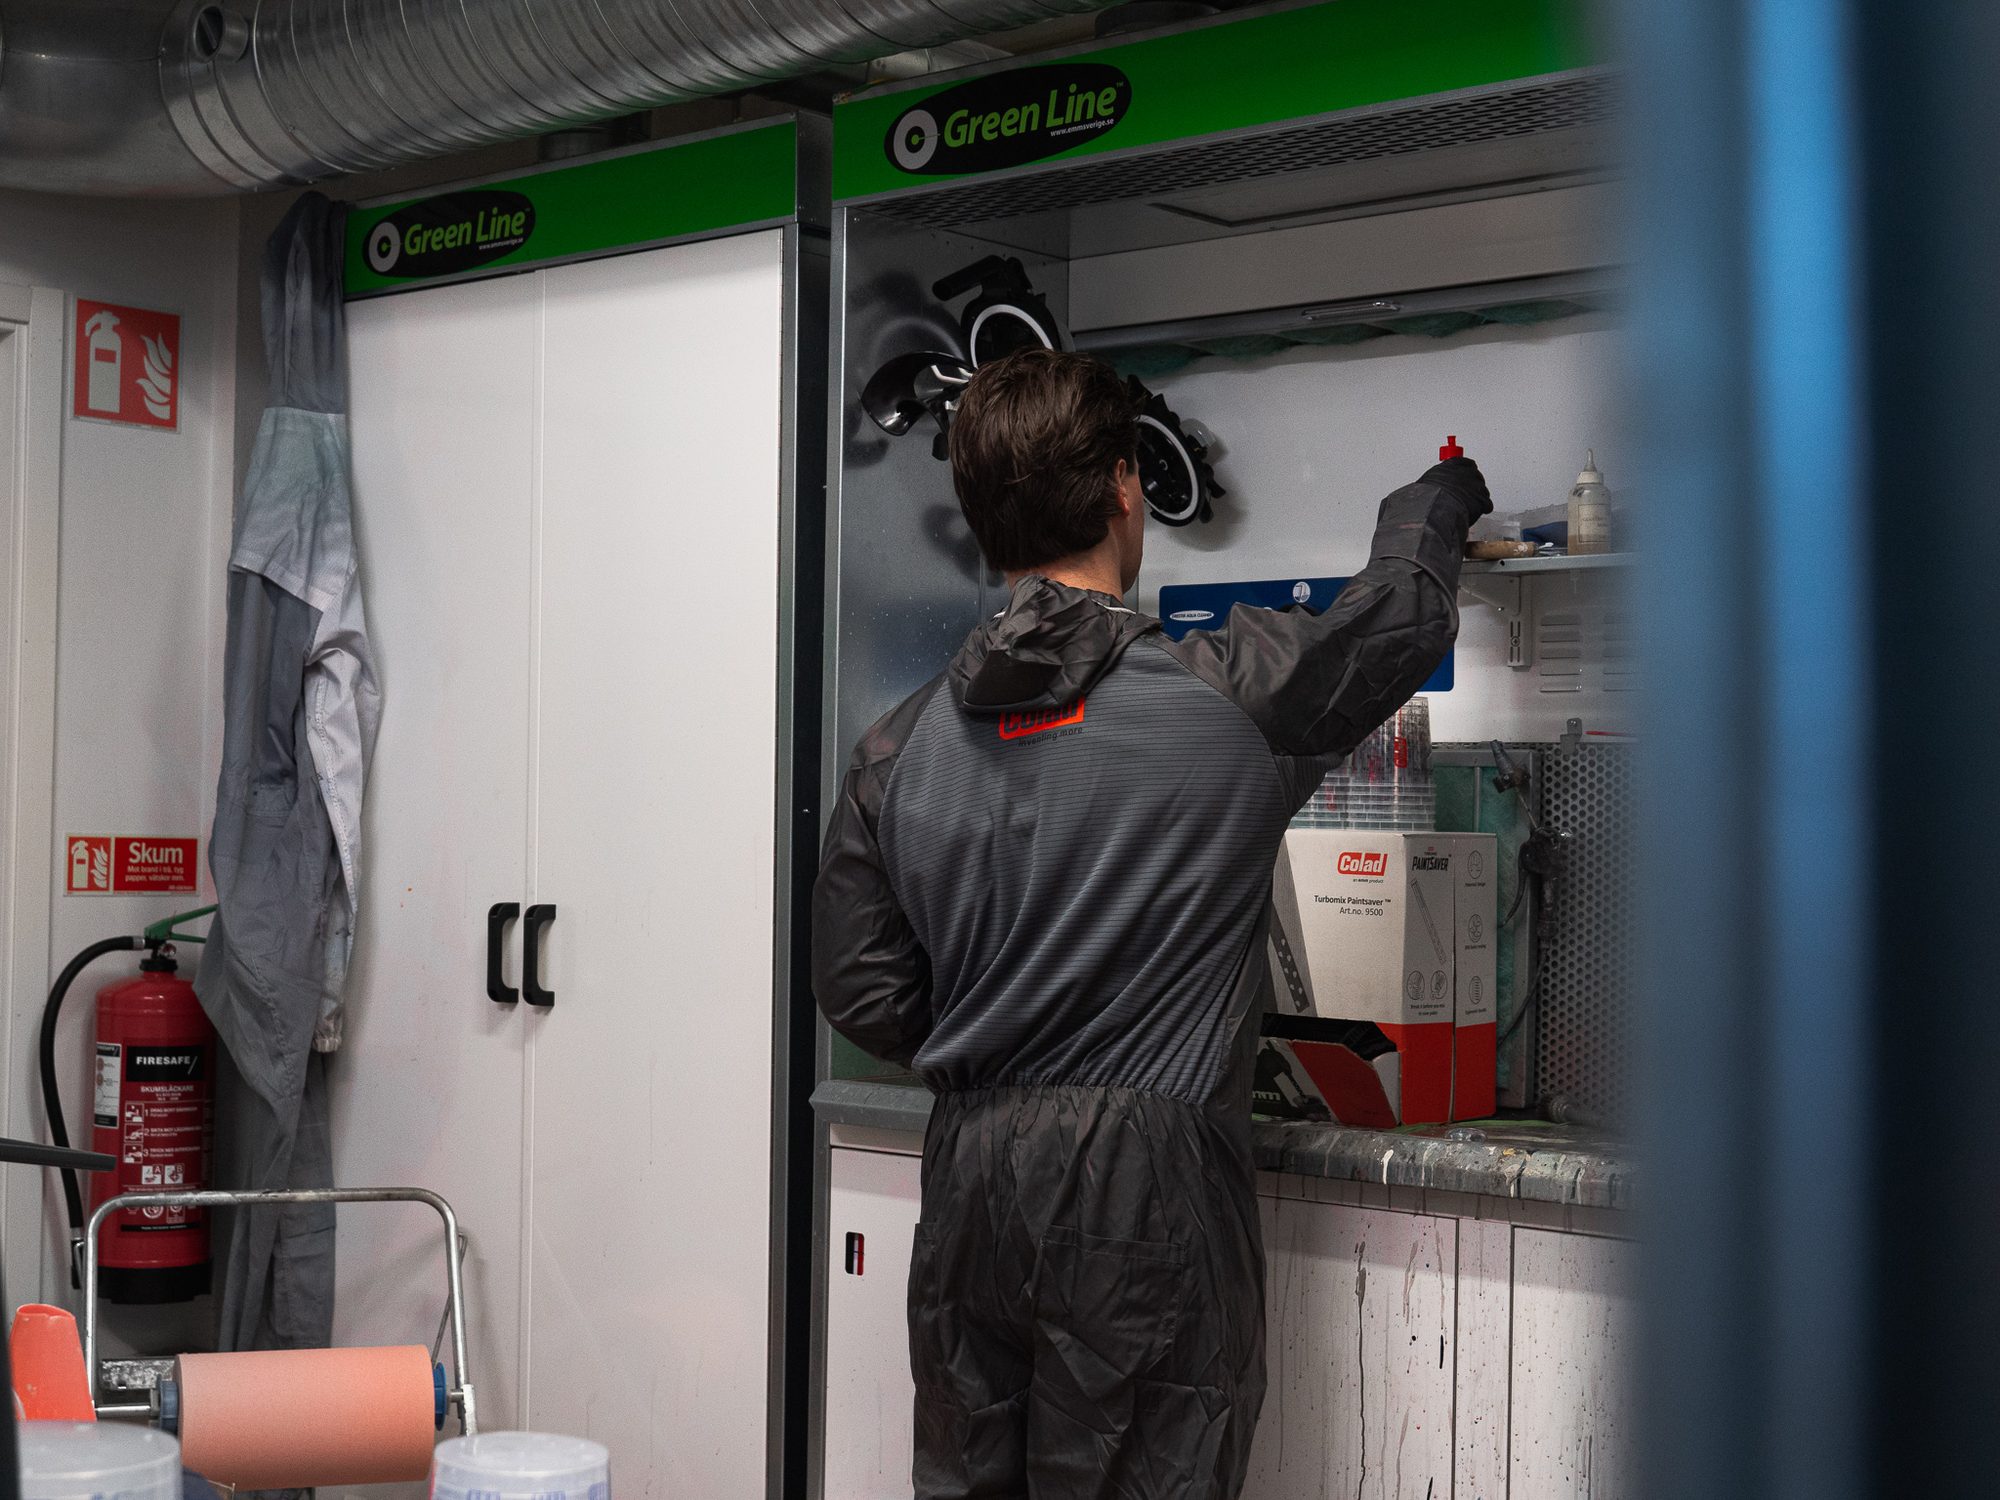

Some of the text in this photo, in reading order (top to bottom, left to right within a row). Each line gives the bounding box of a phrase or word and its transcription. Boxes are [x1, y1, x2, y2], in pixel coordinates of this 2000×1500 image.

[943, 102, 1041, 148] Green
[1045, 83, 1117, 128] Line
[1050, 117, 1115, 137] www.emmsverige.se
[404, 207, 526, 256] Green Line
[128, 841, 184, 864] Skum
[1338, 852, 1385, 874] Colad
[1314, 894, 1347, 905] Turbomix
[1347, 896, 1384, 907] Paintsaver
[1339, 906, 1384, 917] Art.no. 9500
[136, 1056, 191, 1066] FIRESAFE
